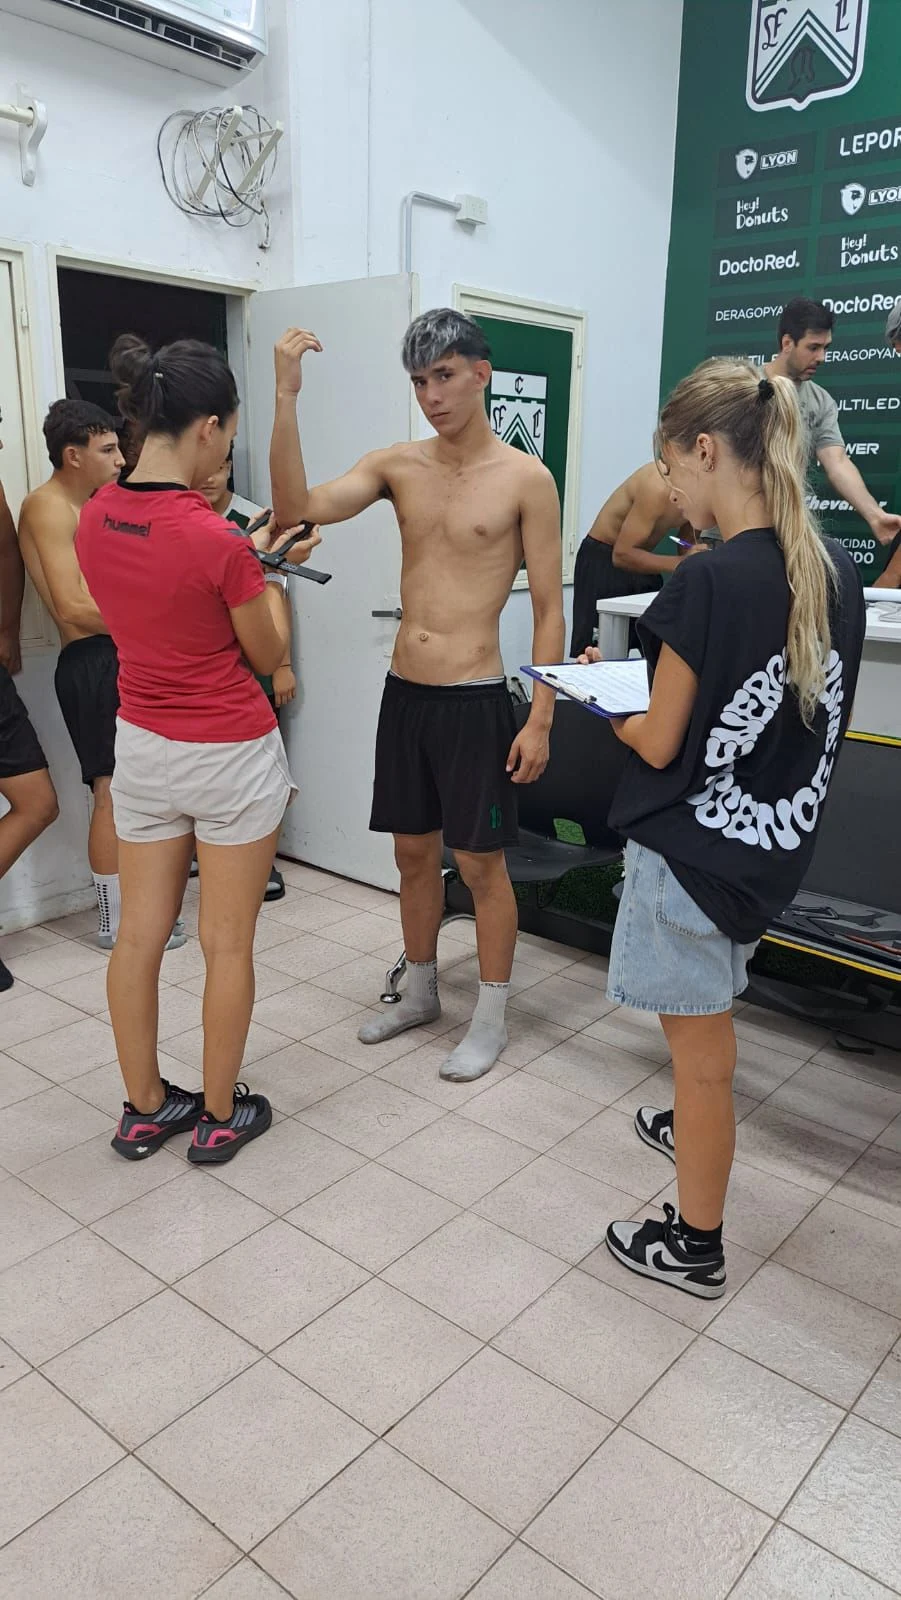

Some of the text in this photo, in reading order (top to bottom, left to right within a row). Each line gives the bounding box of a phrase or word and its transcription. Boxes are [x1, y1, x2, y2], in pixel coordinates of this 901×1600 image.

[760, 150, 798, 169] LYON
[736, 197, 759, 214] Hey!
[736, 206, 789, 230] Donuts
[841, 234, 867, 250] Hey!
[719, 250, 800, 276] DoctoRed.
[840, 244, 898, 268] Donuts
[715, 304, 785, 322] DERAGOPYA
[837, 397, 901, 411] ULTILED
[845, 442, 880, 455] WER
[103, 513, 152, 537] hummel
